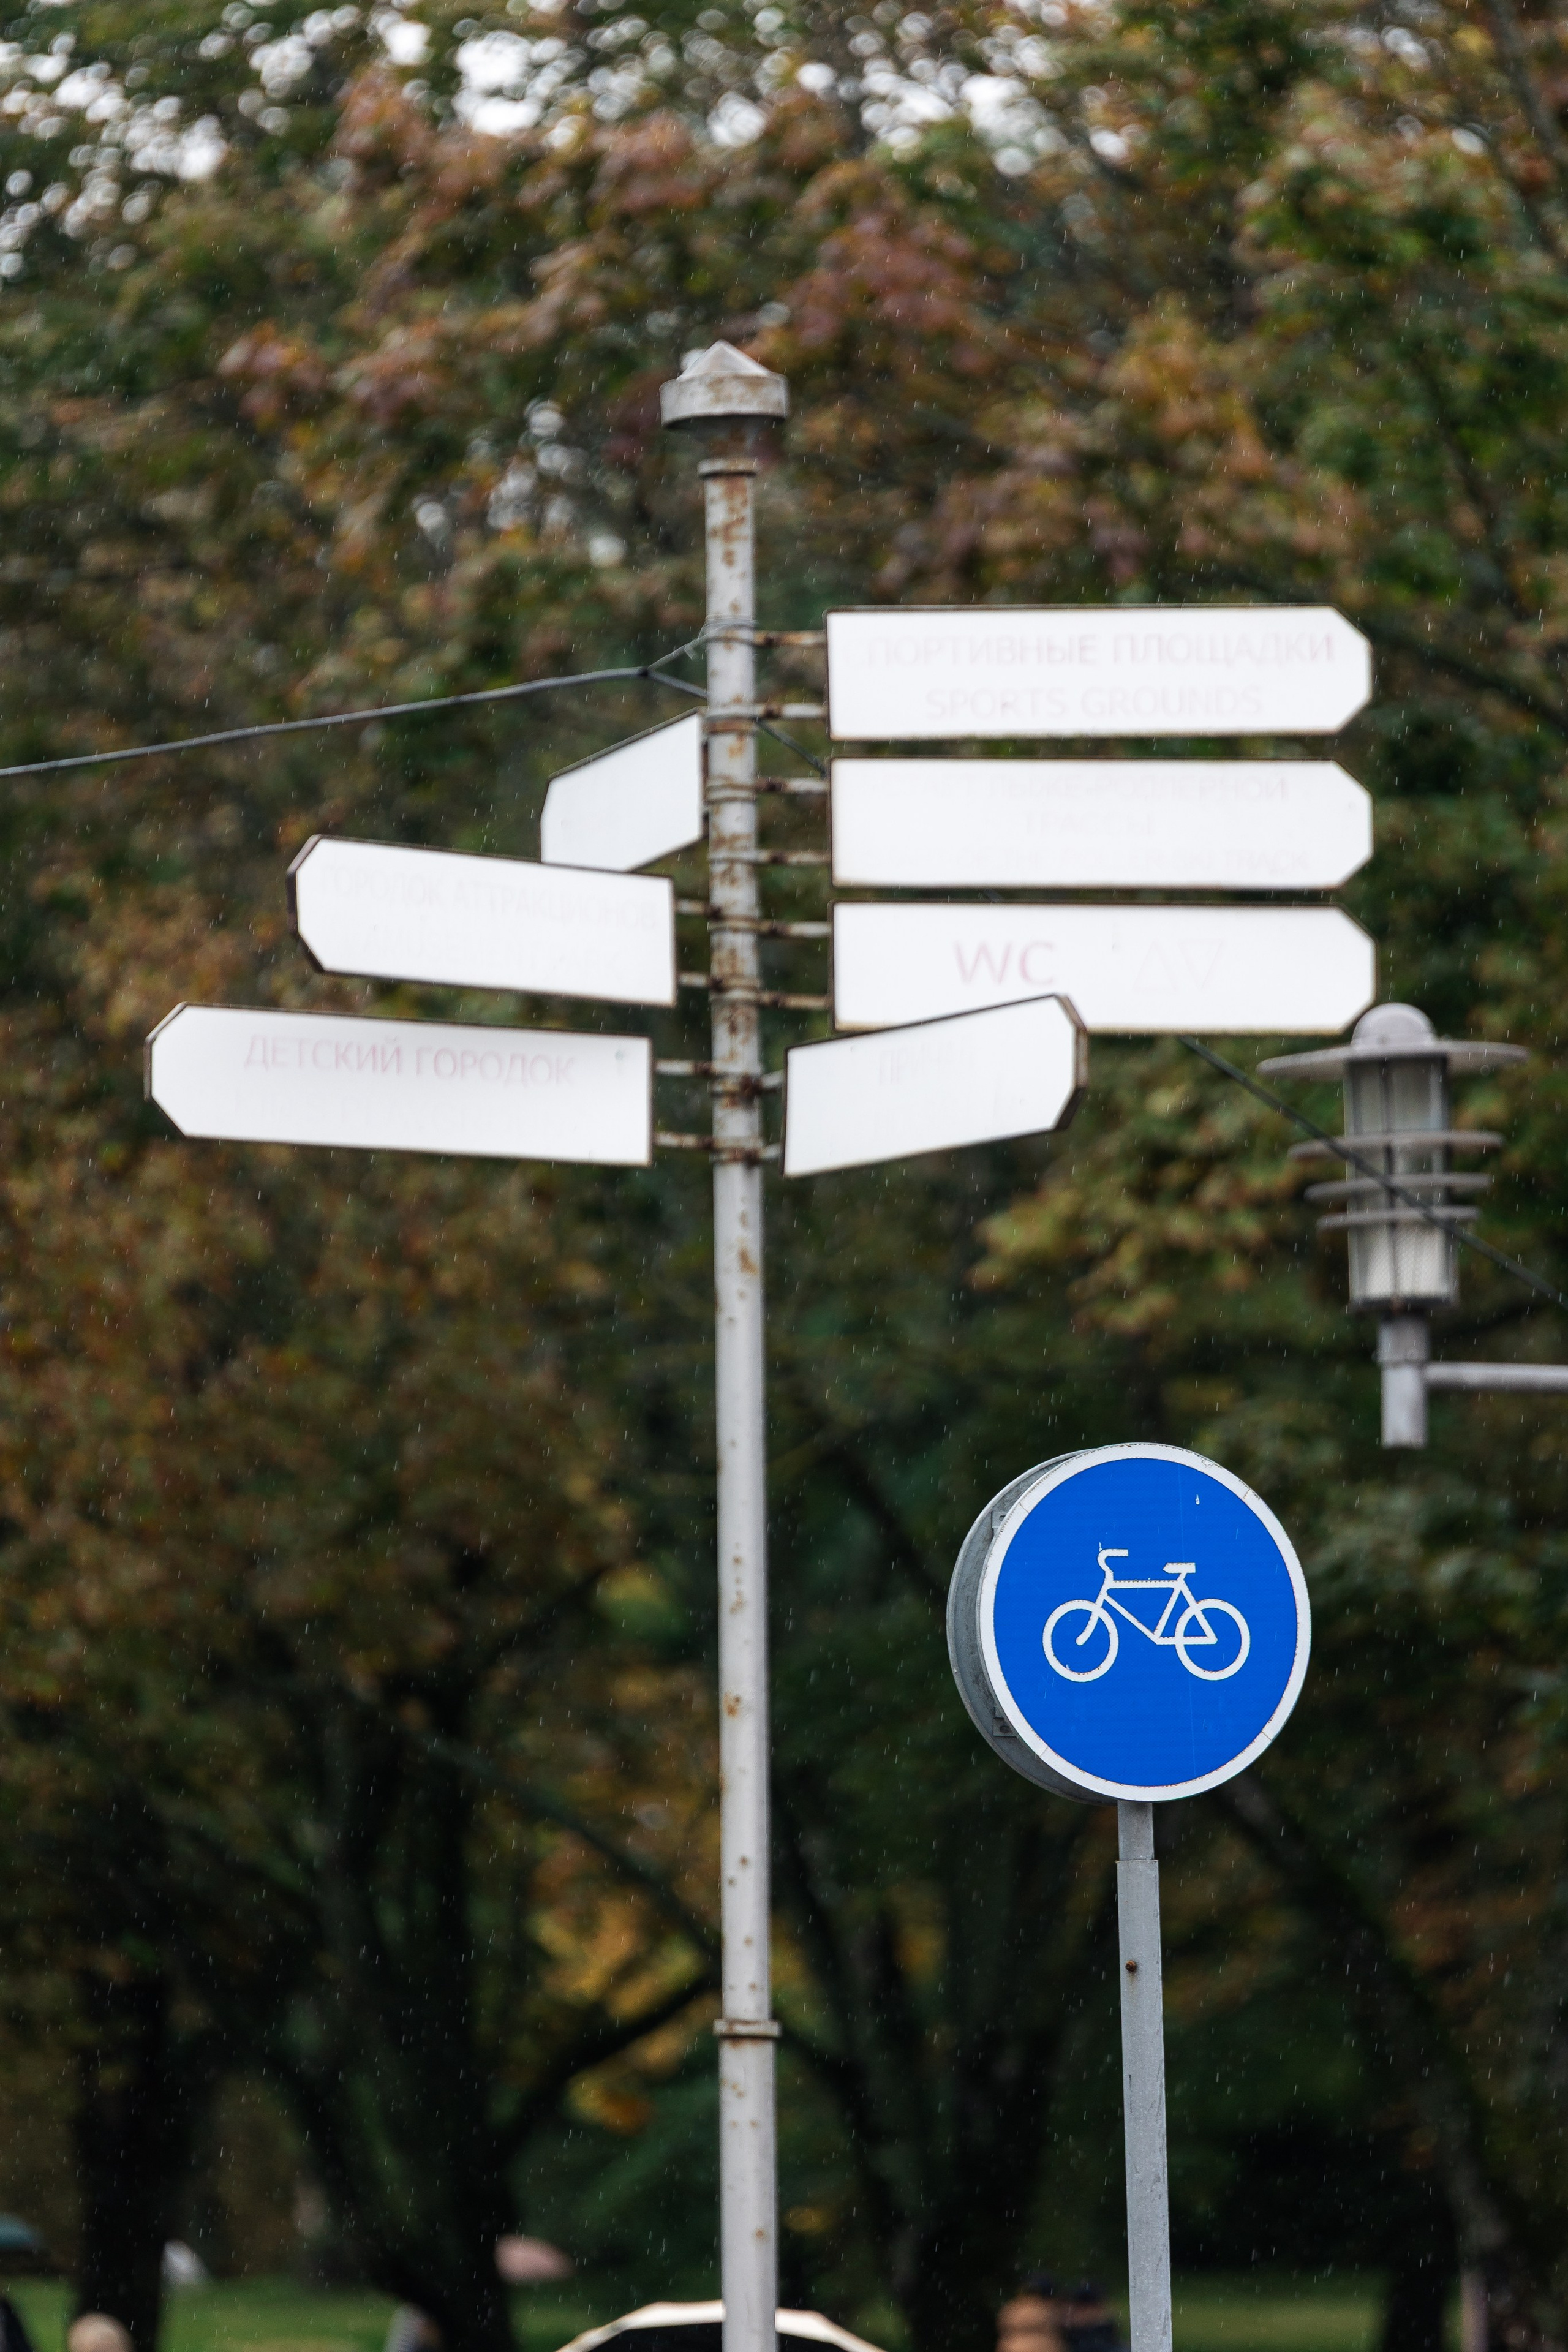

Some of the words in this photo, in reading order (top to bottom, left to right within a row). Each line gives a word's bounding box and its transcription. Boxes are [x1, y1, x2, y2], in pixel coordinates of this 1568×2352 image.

[846, 633, 1098, 668] ПОРТИВНЫЕ
[1113, 631, 1336, 668] ПЛОЩАДКИ
[925, 687, 1067, 720] SPORTS
[1080, 684, 1263, 718] GROUNDS
[953, 940, 1057, 987] WC
[243, 1033, 403, 1077] ДЕТСКИЙ
[415, 1044, 577, 1088] ГОРОДОК
